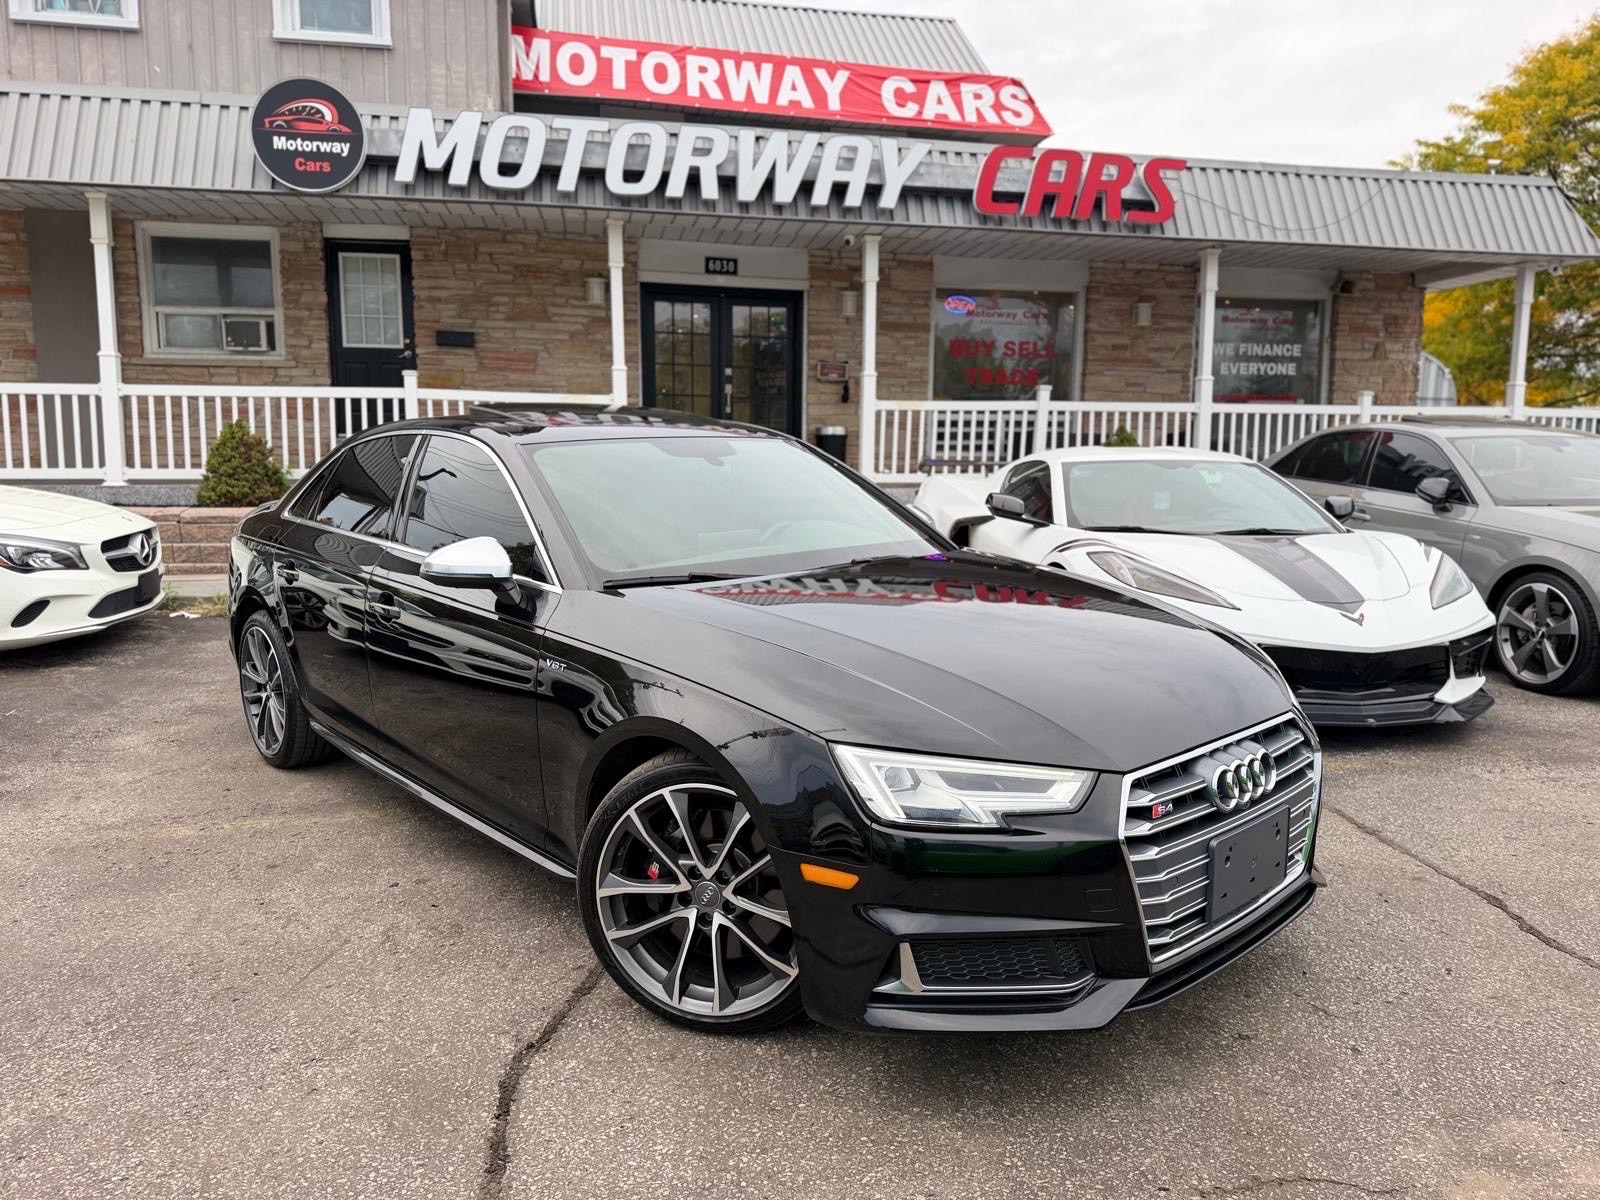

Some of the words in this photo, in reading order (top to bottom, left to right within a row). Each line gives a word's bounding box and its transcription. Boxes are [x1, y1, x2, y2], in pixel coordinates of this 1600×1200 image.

[511, 34, 850, 112] MOTORWAY
[881, 75, 1035, 127] CARS
[272, 135, 351, 158] Motorway
[294, 157, 332, 173] Cars
[394, 107, 933, 210] MOTORWAY
[973, 145, 1188, 225] CARS
[708, 259, 735, 273] 6030
[944, 297, 976, 313] OPEN
[949, 337, 994, 359] BUY
[1003, 339, 1057, 359] SELL
[1239, 343, 1302, 357] FINANCE
[966, 367, 1040, 386] TRADE
[1220, 362, 1297, 376] EVERYONE
[546, 658, 567, 672] V6T
